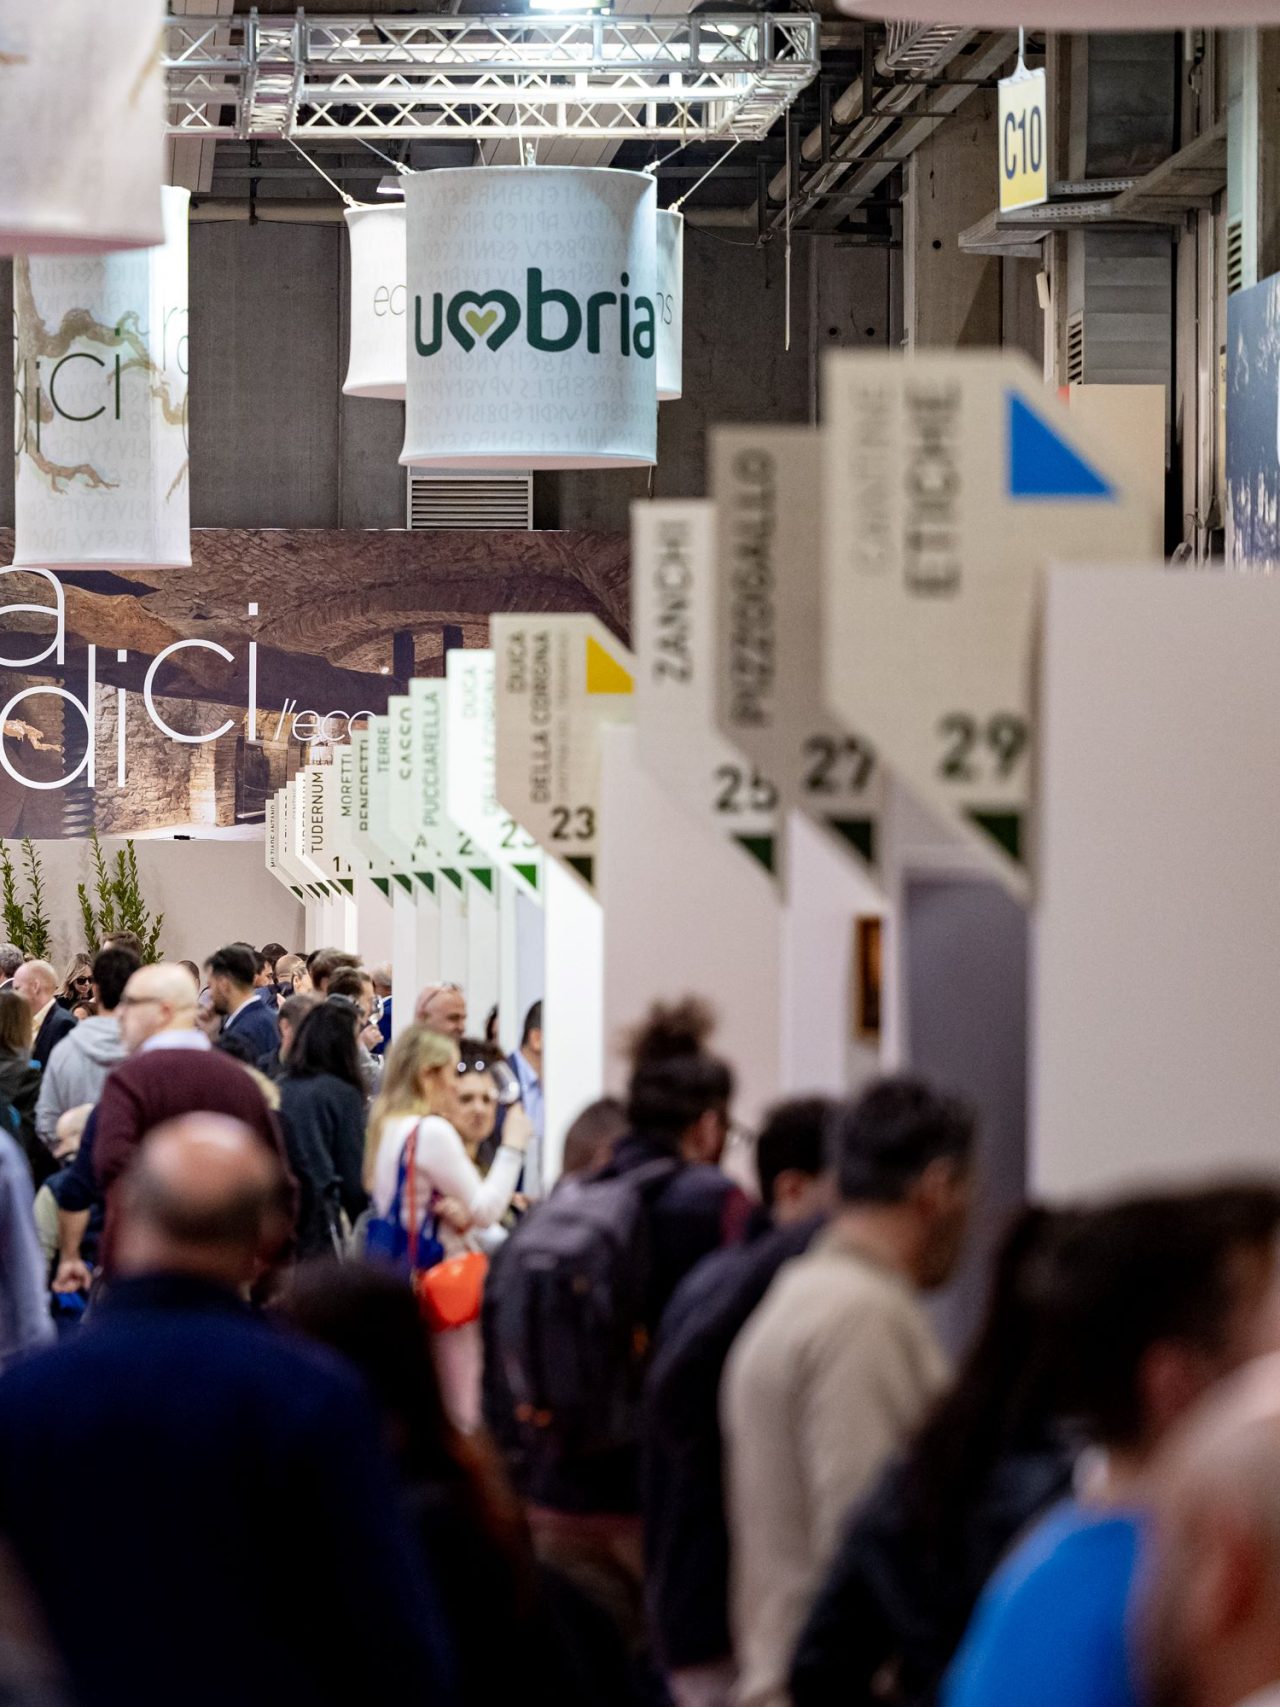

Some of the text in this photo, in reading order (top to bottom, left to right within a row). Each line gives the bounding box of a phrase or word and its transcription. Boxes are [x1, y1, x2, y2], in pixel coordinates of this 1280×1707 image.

[1004, 105, 1043, 180] C10
[415, 267, 656, 359] umbria
[377, 726, 390, 774] TERRE
[423, 691, 440, 827] PUCCIARELLA
[805, 735, 877, 795] 27
[939, 711, 1026, 783] 29
[311, 771, 324, 854] TUDERNUM
[340, 753, 352, 817] MORETTI
[551, 805, 596, 840] 23
